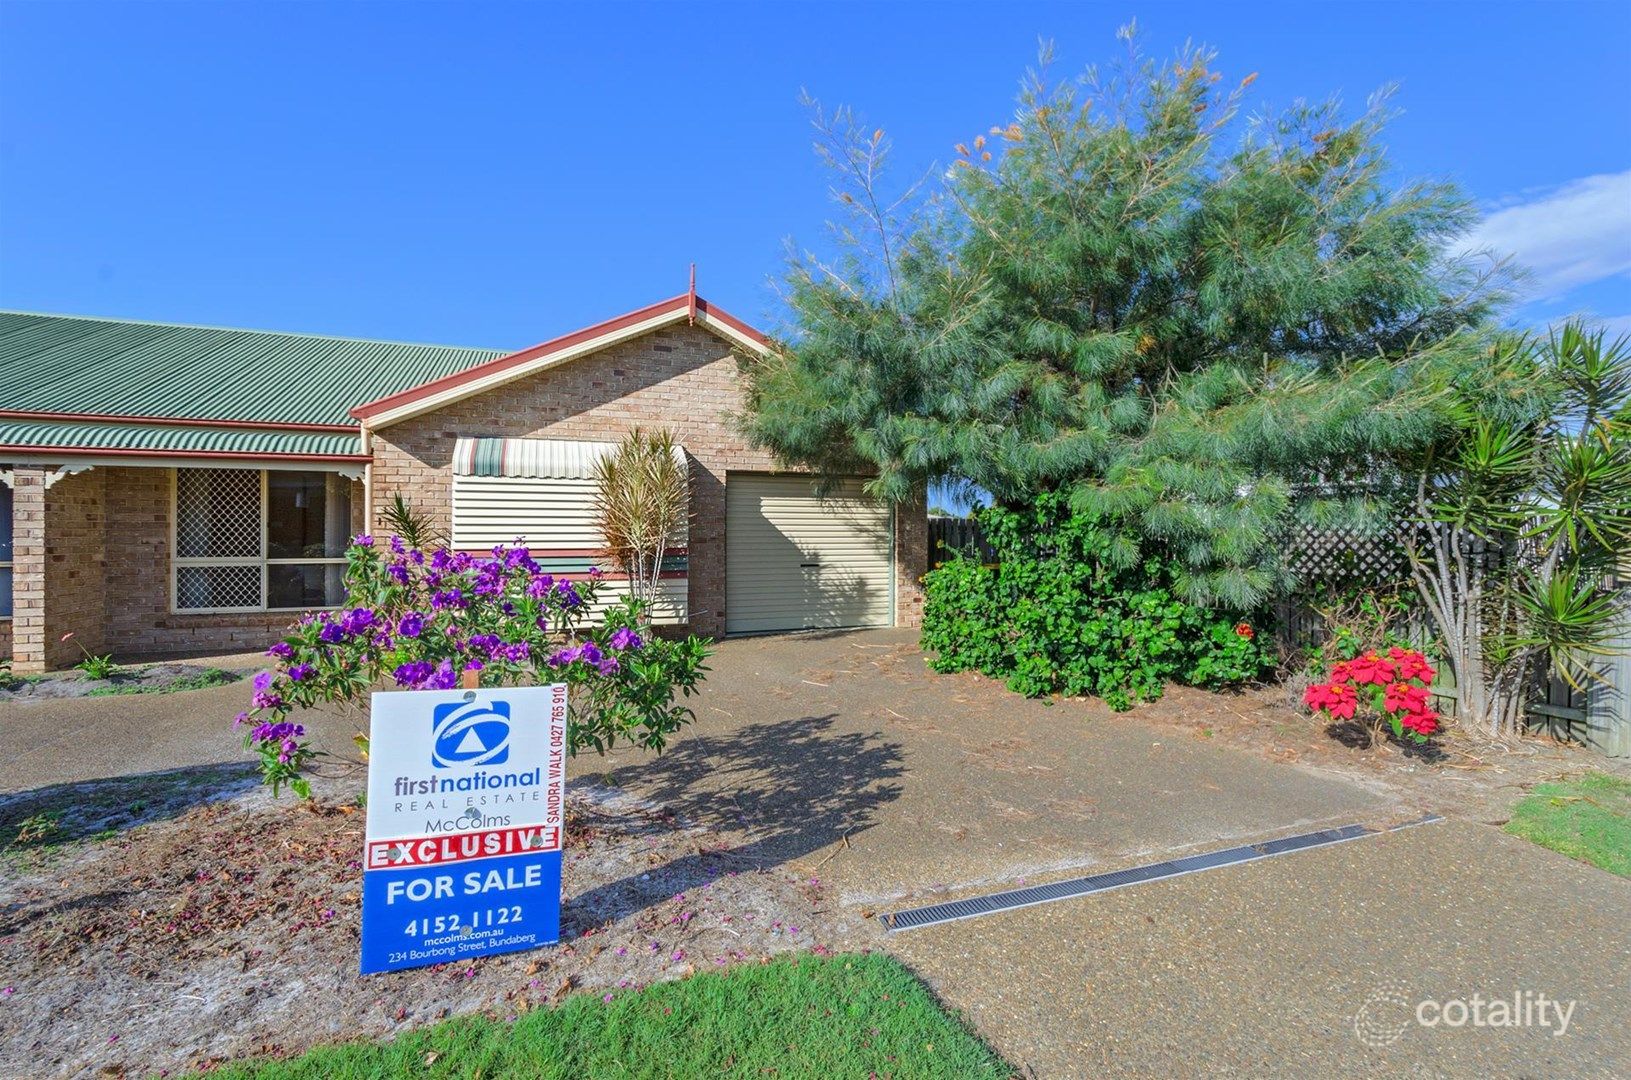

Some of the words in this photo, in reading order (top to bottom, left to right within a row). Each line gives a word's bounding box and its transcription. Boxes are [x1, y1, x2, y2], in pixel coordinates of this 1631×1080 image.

[552, 706, 565, 722] 765
[551, 724, 564, 748] 0427
[549, 750, 562, 779] WALK
[394, 800, 448, 812] REAL
[467, 791, 540, 806] ESTATE
[547, 781, 561, 823] SANDRA
[425, 814, 511, 834] McColms
[371, 828, 556, 866] EXCLUSIVE
[386, 875, 455, 905] FOR
[463, 864, 542, 895] SALE
[404, 915, 460, 937] 4152
[473, 905, 523, 928] 1122
[388, 951, 407, 963] 234
[410, 944, 456, 960] Bourbong
[458, 938, 487, 952] Street,
[489, 933, 536, 948] Bundaberg
[424, 928, 504, 946] mccolms.com.au
